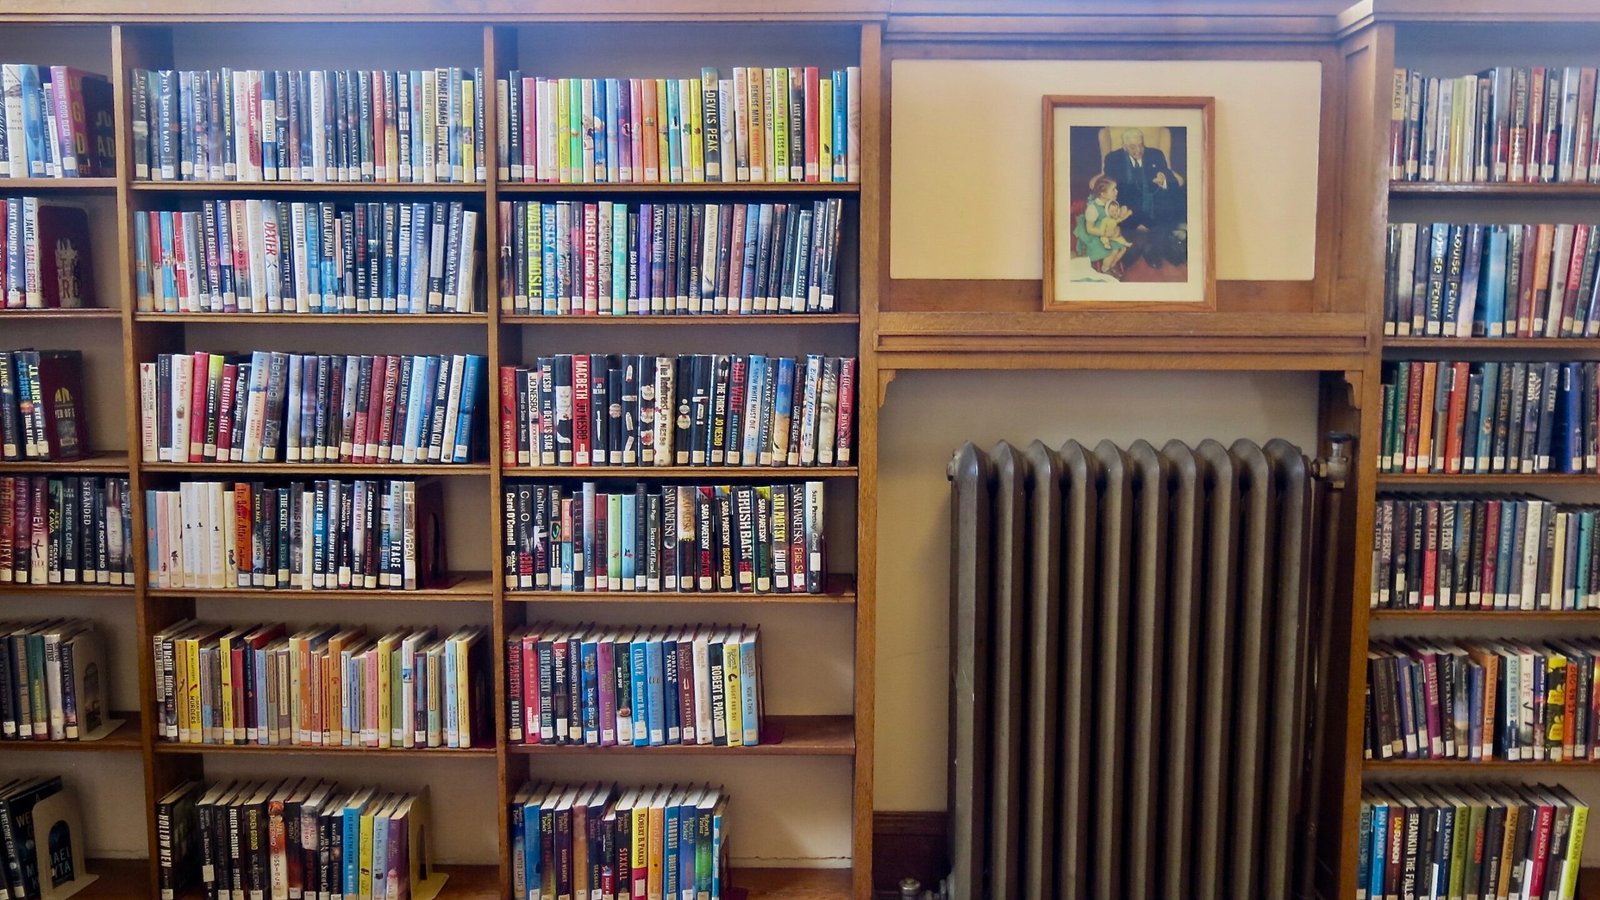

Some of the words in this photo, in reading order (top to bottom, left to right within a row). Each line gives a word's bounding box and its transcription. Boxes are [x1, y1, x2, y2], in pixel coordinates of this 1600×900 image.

[438, 71, 447, 95] ELMORE
[439, 96, 448, 124] LEONARD
[706, 91, 716, 123] DEVIL'S
[707, 128, 718, 152] PEAK
[205, 204, 215, 226] DEXTER
[323, 207, 332, 227] LAURA
[9, 222, 17, 255] WOUNDS
[207, 228, 215, 236] BY
[264, 222, 277, 256] DEXTER
[324, 229, 332, 256] LIPPMAN
[208, 238, 217, 259] DESIGN
[1452, 234, 1461, 275] LOUISE
[210, 269, 219, 284] JEFF
[1447, 283, 1457, 320] PENNY
[29, 365, 38, 378] J.A.
[401, 360, 412, 386] MARGARET
[529, 376, 537, 386] JO
[576, 361, 588, 400] MACBETH
[751, 368, 760, 384] SNOW
[1412, 367, 1421, 392] ANNE
[1502, 367, 1511, 392] ANNE
[31, 380, 40, 404] JANCE
[400, 387, 409, 405] MARON
[716, 382, 726, 394] THE
[750, 385, 759, 402] WHITE
[764, 367, 773, 402] STUART
[577, 403, 586, 413] JO
[715, 395, 725, 415] THIRST
[749, 404, 757, 419] MUST
[1411, 394, 1420, 420] PERRY
[1499, 393, 1509, 421] PERRY
[543, 410, 552, 433] DEVIL'S
[715, 417, 724, 426] JO
[748, 420, 756, 429] DIE
[761, 405, 771, 448] NEVILLE
[544, 435, 553, 450] STAR
[83, 481, 91, 525] STRANDED
[506, 493, 515, 511] Carol
[664, 488, 674, 506] SARA
[721, 501, 729, 516] SARA
[758, 499, 766, 513] SARA
[774, 494, 785, 510] SARA
[794, 488, 803, 507] SARA
[664, 506, 674, 537] PARETSKY
[701, 504, 709, 519] SARA
[738, 491, 750, 529] BRUSH
[1383, 505, 1392, 531] ANNE
[1443, 506, 1454, 527] ANNE
[33, 517, 43, 535] EVIL
[315, 513, 323, 531] MAYOR
[506, 513, 516, 546] O'Connell
[722, 516, 730, 546] PARETSKY
[774, 511, 785, 542] PARETSKY
[793, 508, 803, 545] PARETSKY
[701, 521, 710, 550] PARETSKY
[741, 531, 752, 559] BACK
[1382, 533, 1391, 560] PERRY
[1441, 528, 1453, 550] PERRY
[84, 538, 92, 557] ALEX
[315, 548, 323, 557] THE
[794, 547, 803, 563] FIRE
[315, 558, 323, 571] LEAD
[775, 550, 785, 573] FALLOUT
[509, 646, 520, 663] SARA
[540, 650, 550, 665] SARA
[556, 649, 564, 667] Barbara
[510, 665, 521, 698] PARETSKY
[540, 665, 551, 692] PARETSKY
[556, 668, 565, 683] Parker
[712, 666, 722, 694] ROBERT
[1523, 673, 1531, 697] FIVE
[541, 696, 552, 712] SHELL
[542, 713, 552, 727] GAME
[588, 708, 596, 728] Story
[2, 814, 12, 840] WELCOME
[158, 814, 171, 847] HOLLOW
[6, 841, 15, 858] GRAVE
[1377, 827, 1385, 859] RANKIN
[1506, 829, 1515, 860] RANKIN
[1538, 828, 1547, 859] RANKIN
[1572, 829, 1582, 859] RANKIN
[160, 849, 172, 867] MEN
[619, 848, 627, 881] SIXKILL
